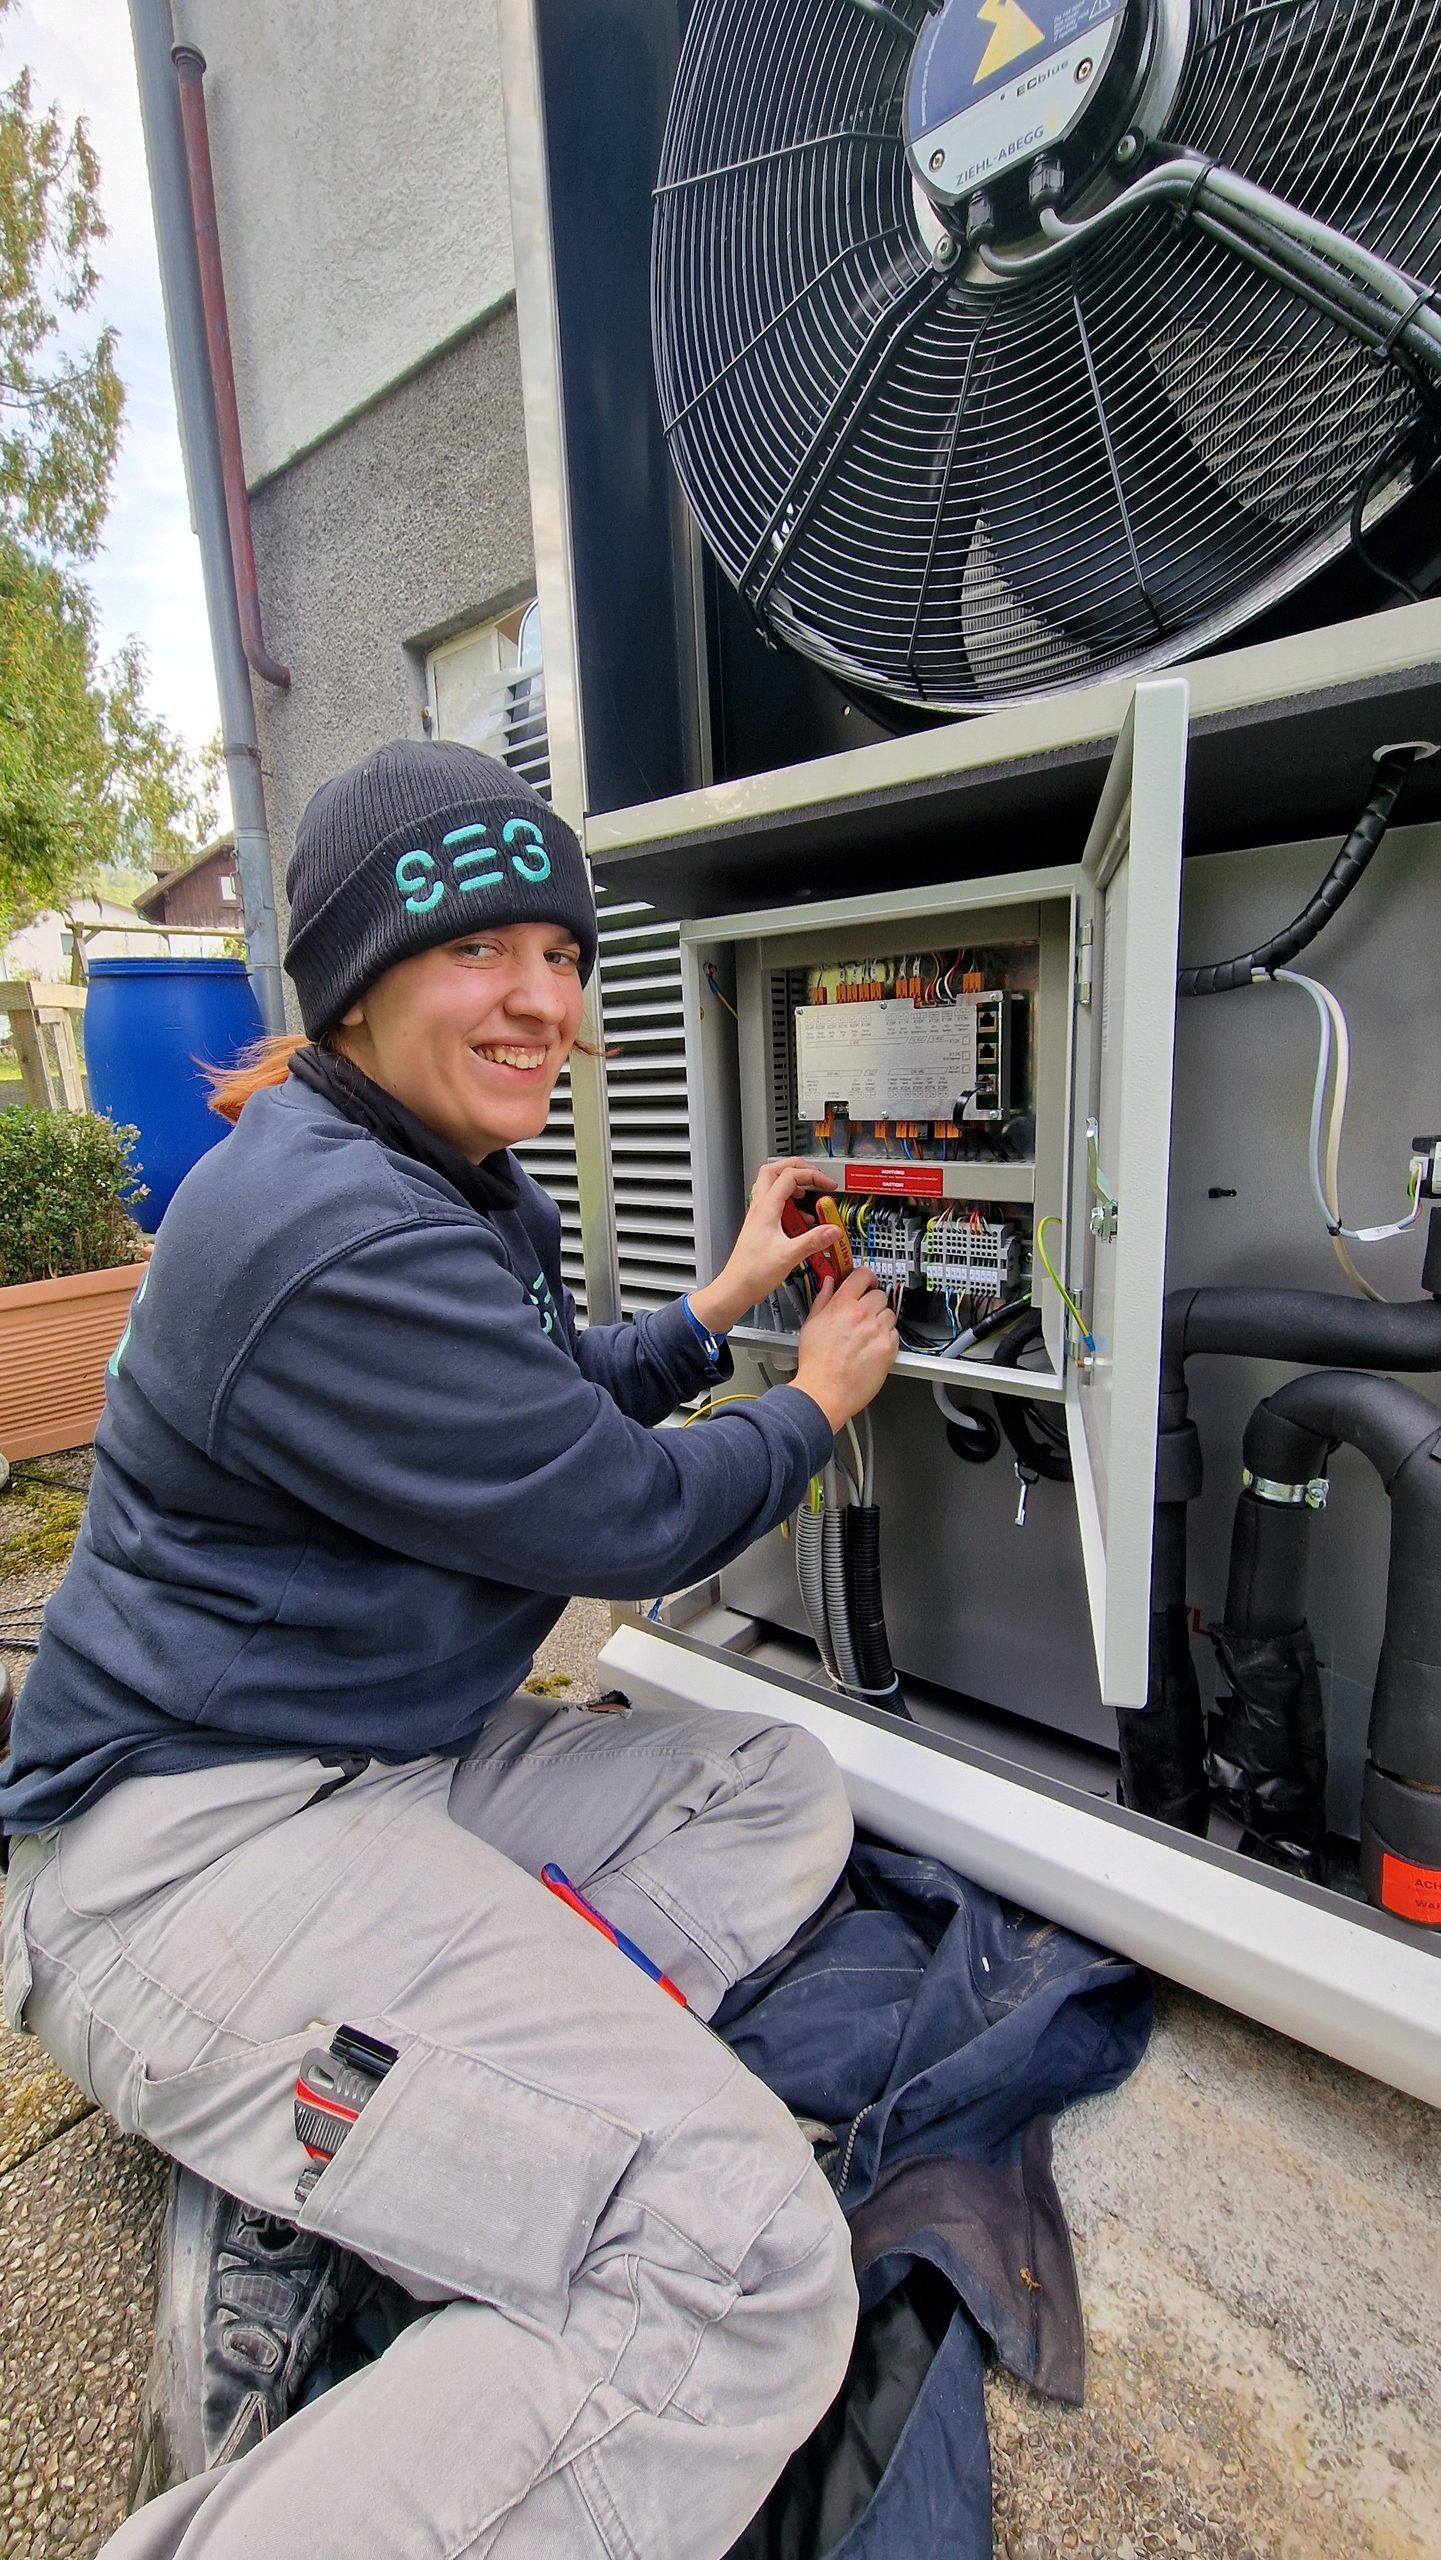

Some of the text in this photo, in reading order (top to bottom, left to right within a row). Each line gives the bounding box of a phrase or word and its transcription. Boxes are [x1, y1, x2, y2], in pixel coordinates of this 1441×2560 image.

[1016, 60, 1069, 97] ECblue
[956, 125, 1044, 187] ZIEHL-ABEGG
[838, 1239, 850, 1266] KNIP
